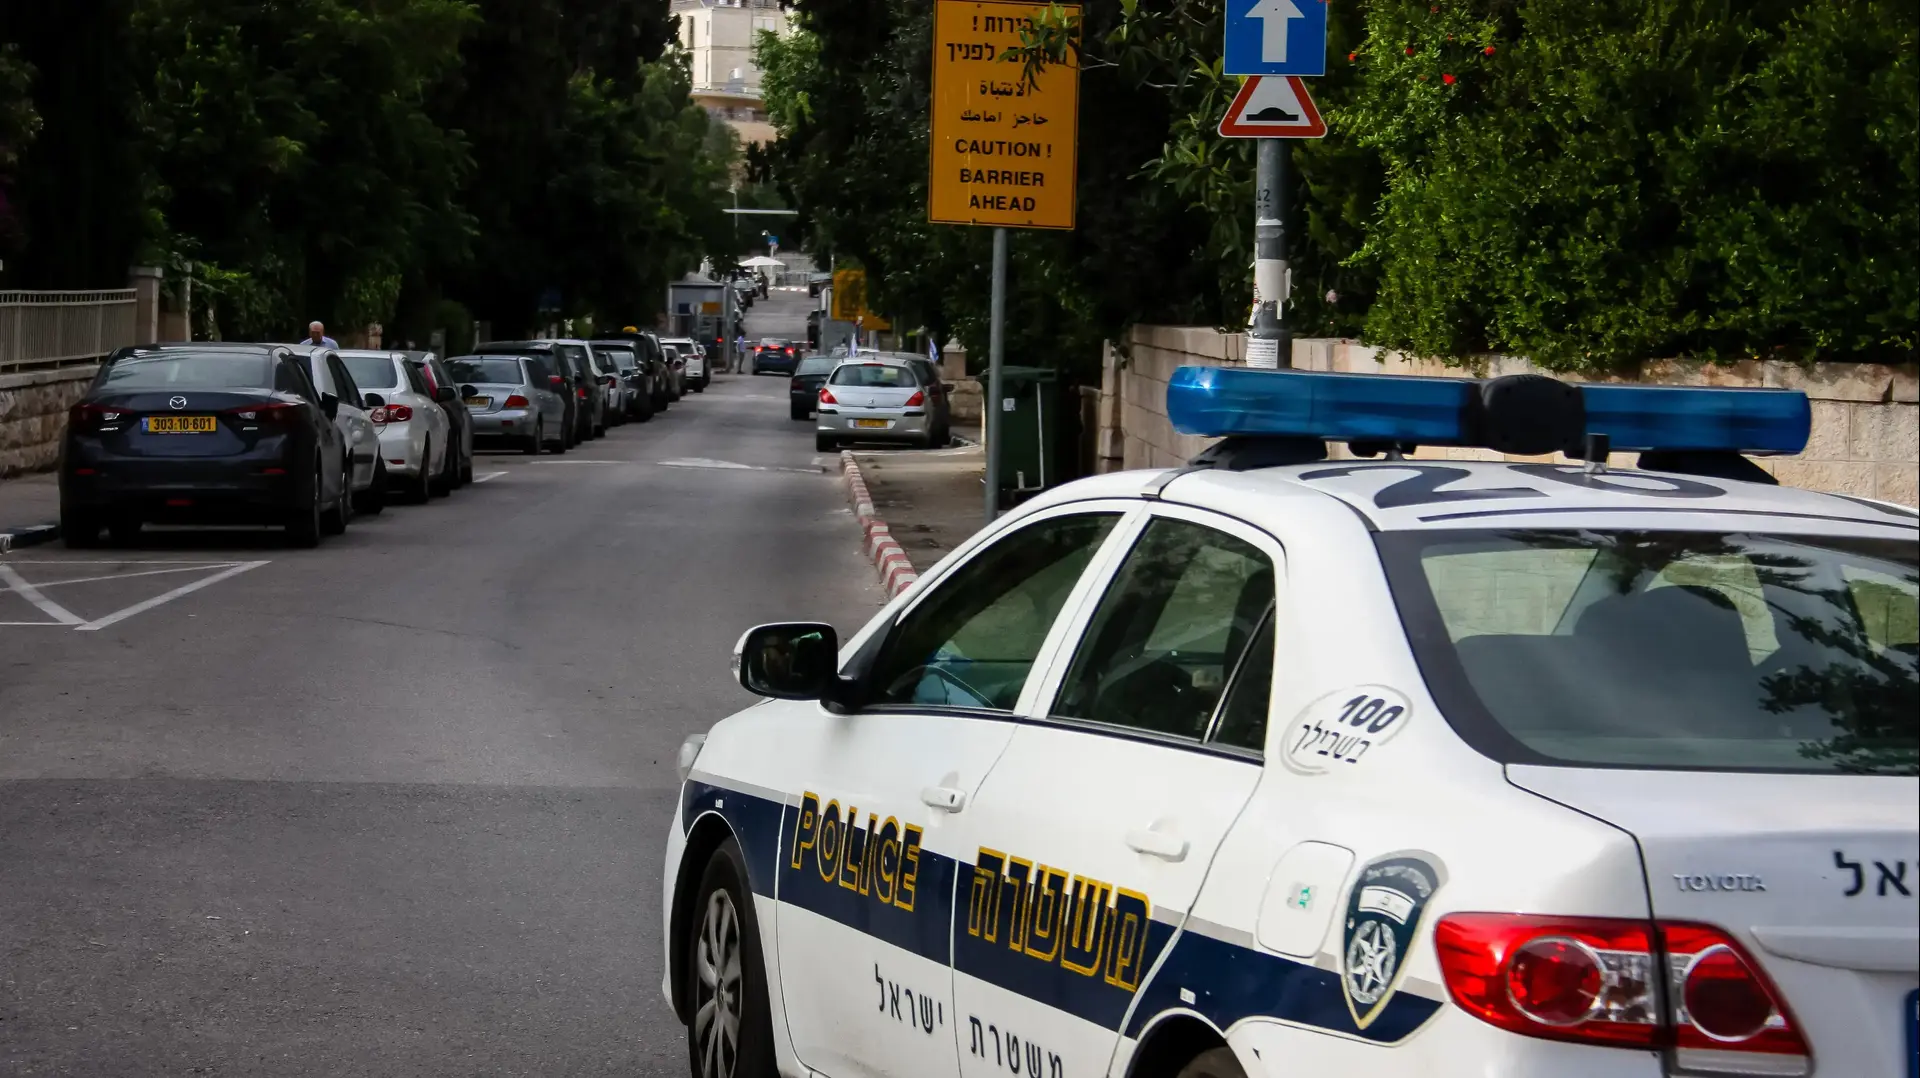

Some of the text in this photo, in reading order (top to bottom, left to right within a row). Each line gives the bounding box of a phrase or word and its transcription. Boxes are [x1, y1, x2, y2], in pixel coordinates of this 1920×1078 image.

[946, 42, 995, 62] לפניך
[1012, 113, 1049, 129] حاجز
[960, 169, 1044, 187] BARRIER
[969, 195, 1036, 212] AHEAD
[1338, 694, 1404, 733] 100
[1291, 720, 1371, 763] בשבילך
[791, 790, 924, 912] POLICE
[1672, 873, 1767, 892] TOYOTA
[968, 846, 1150, 993] משטרה
[874, 962, 1064, 1078] משטרת ישראל
